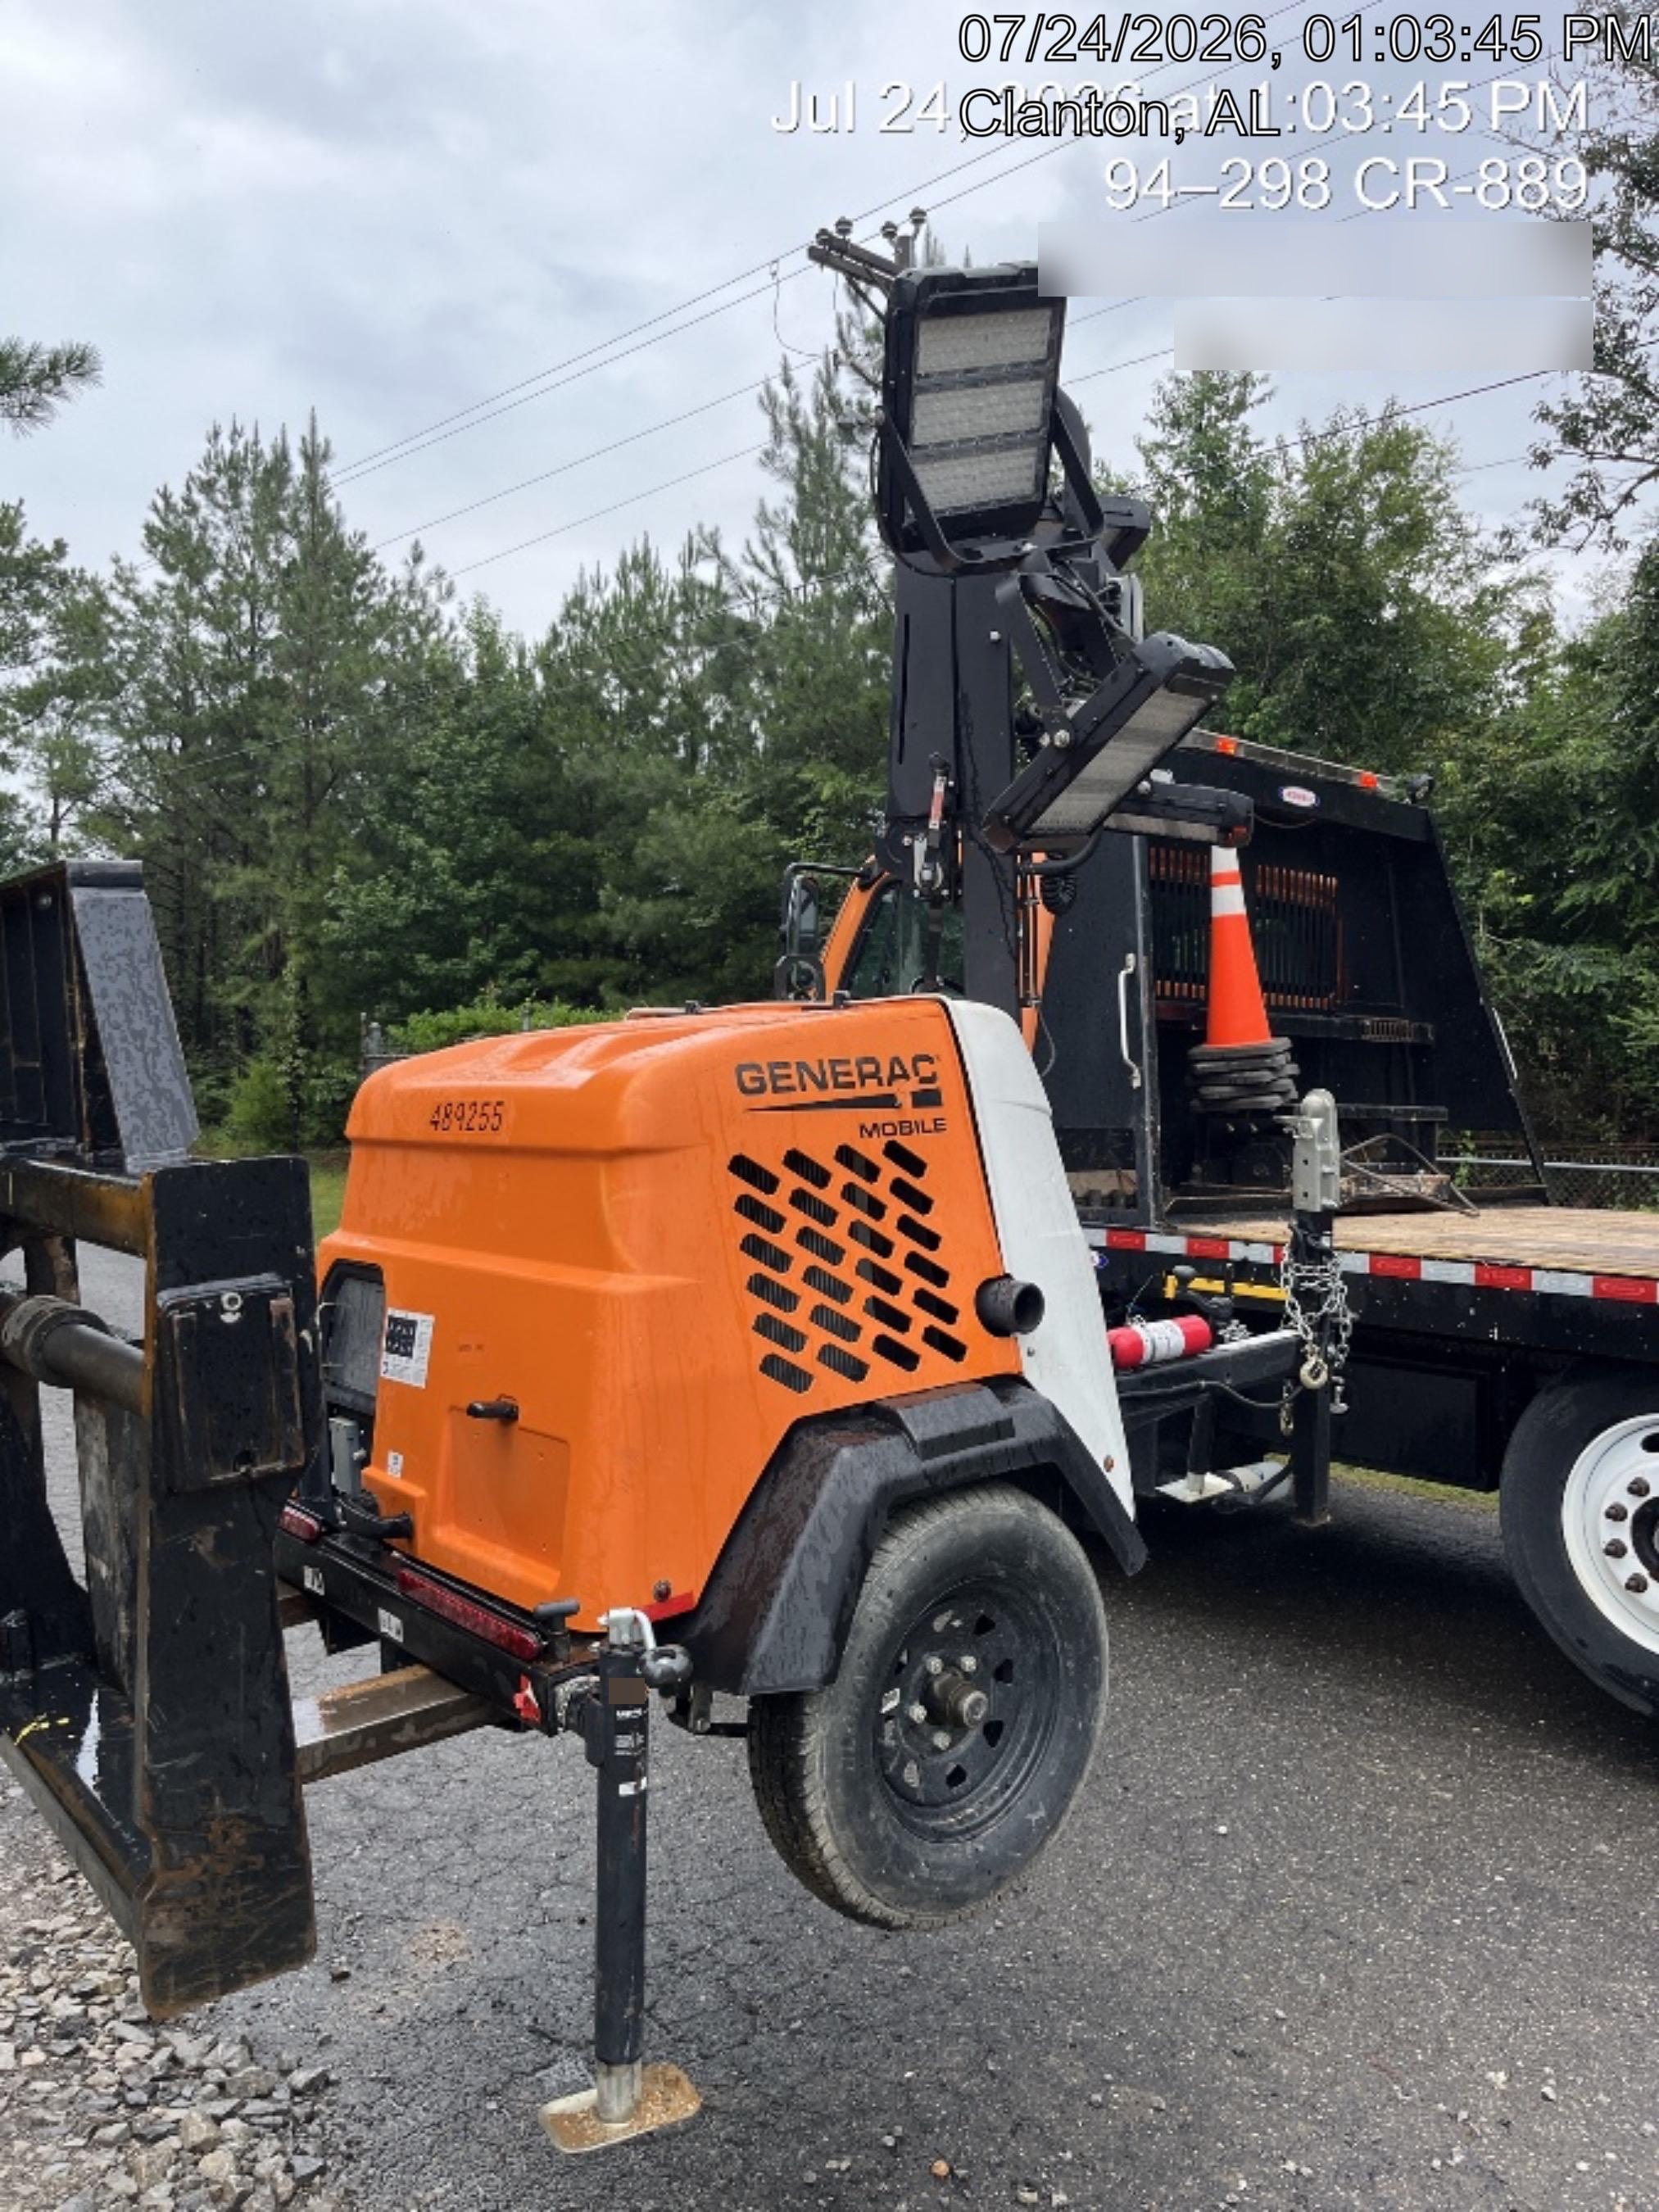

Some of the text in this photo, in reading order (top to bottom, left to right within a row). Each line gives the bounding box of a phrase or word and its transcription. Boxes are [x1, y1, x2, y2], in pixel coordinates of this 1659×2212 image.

[735, 1054, 938, 1095] GENERAC
[429, 1101, 505, 1131] 489255
[859, 1117, 946, 1139] MOBILE
